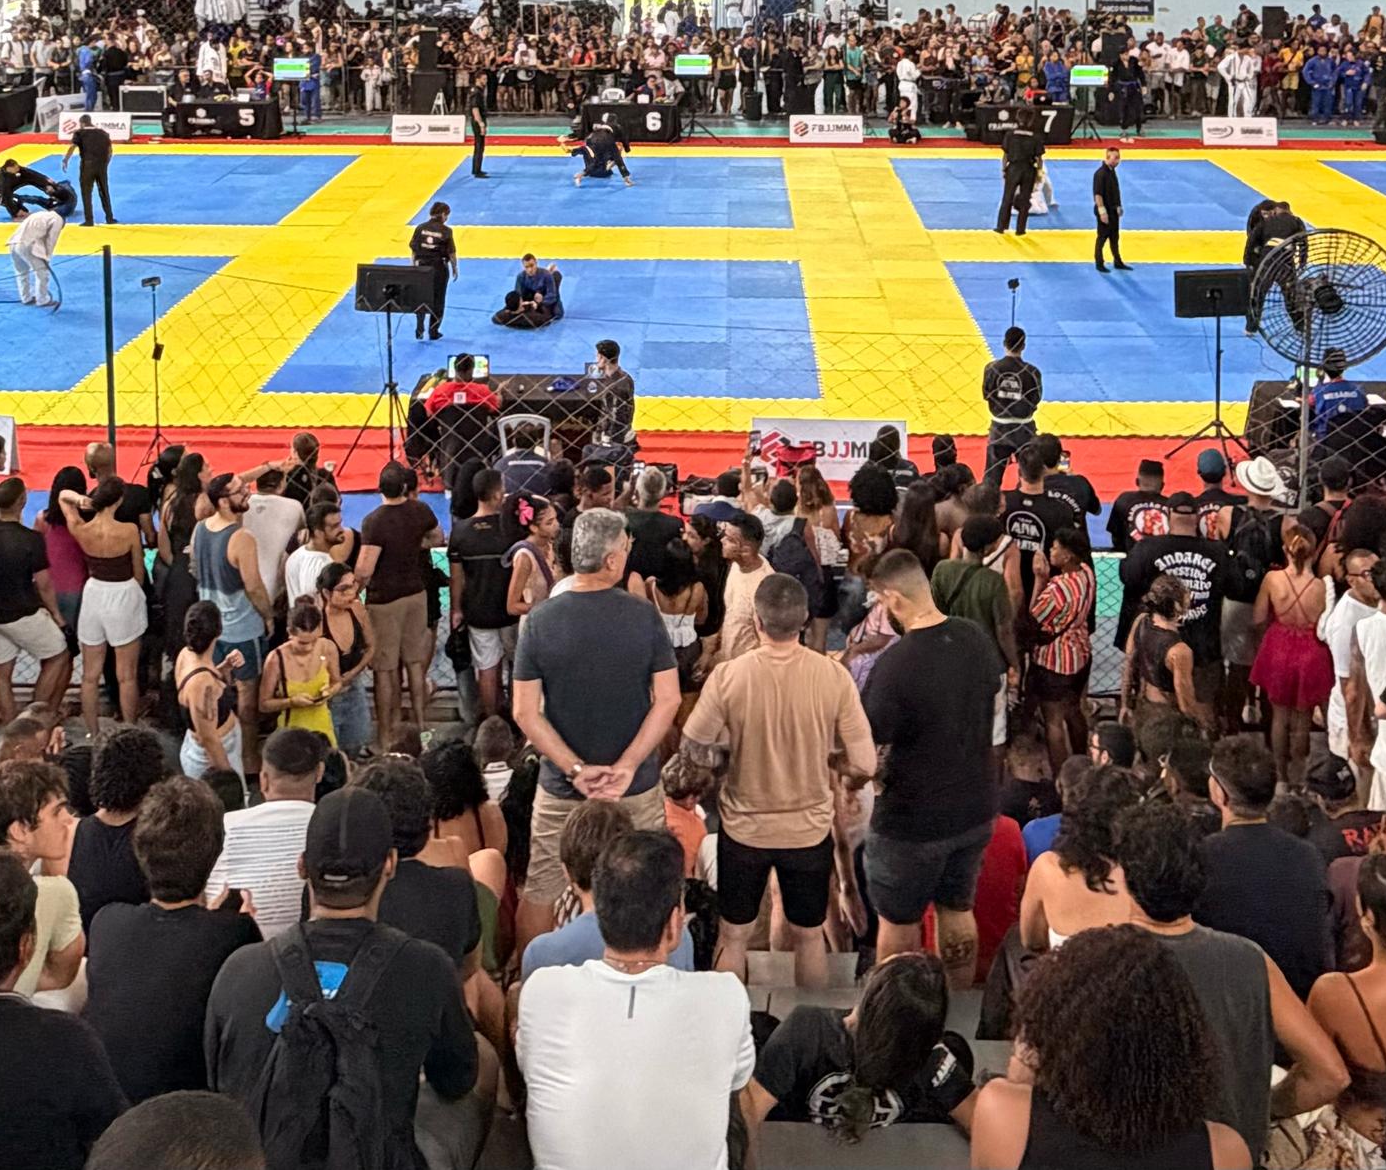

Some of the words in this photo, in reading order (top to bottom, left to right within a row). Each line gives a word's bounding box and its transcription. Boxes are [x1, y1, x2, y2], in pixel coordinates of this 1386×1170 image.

[238, 108, 255, 127] 5
[645, 111, 662, 132] 6
[1041, 110, 1057, 133] 7
[811, 124, 860, 133] FBJJMMA
